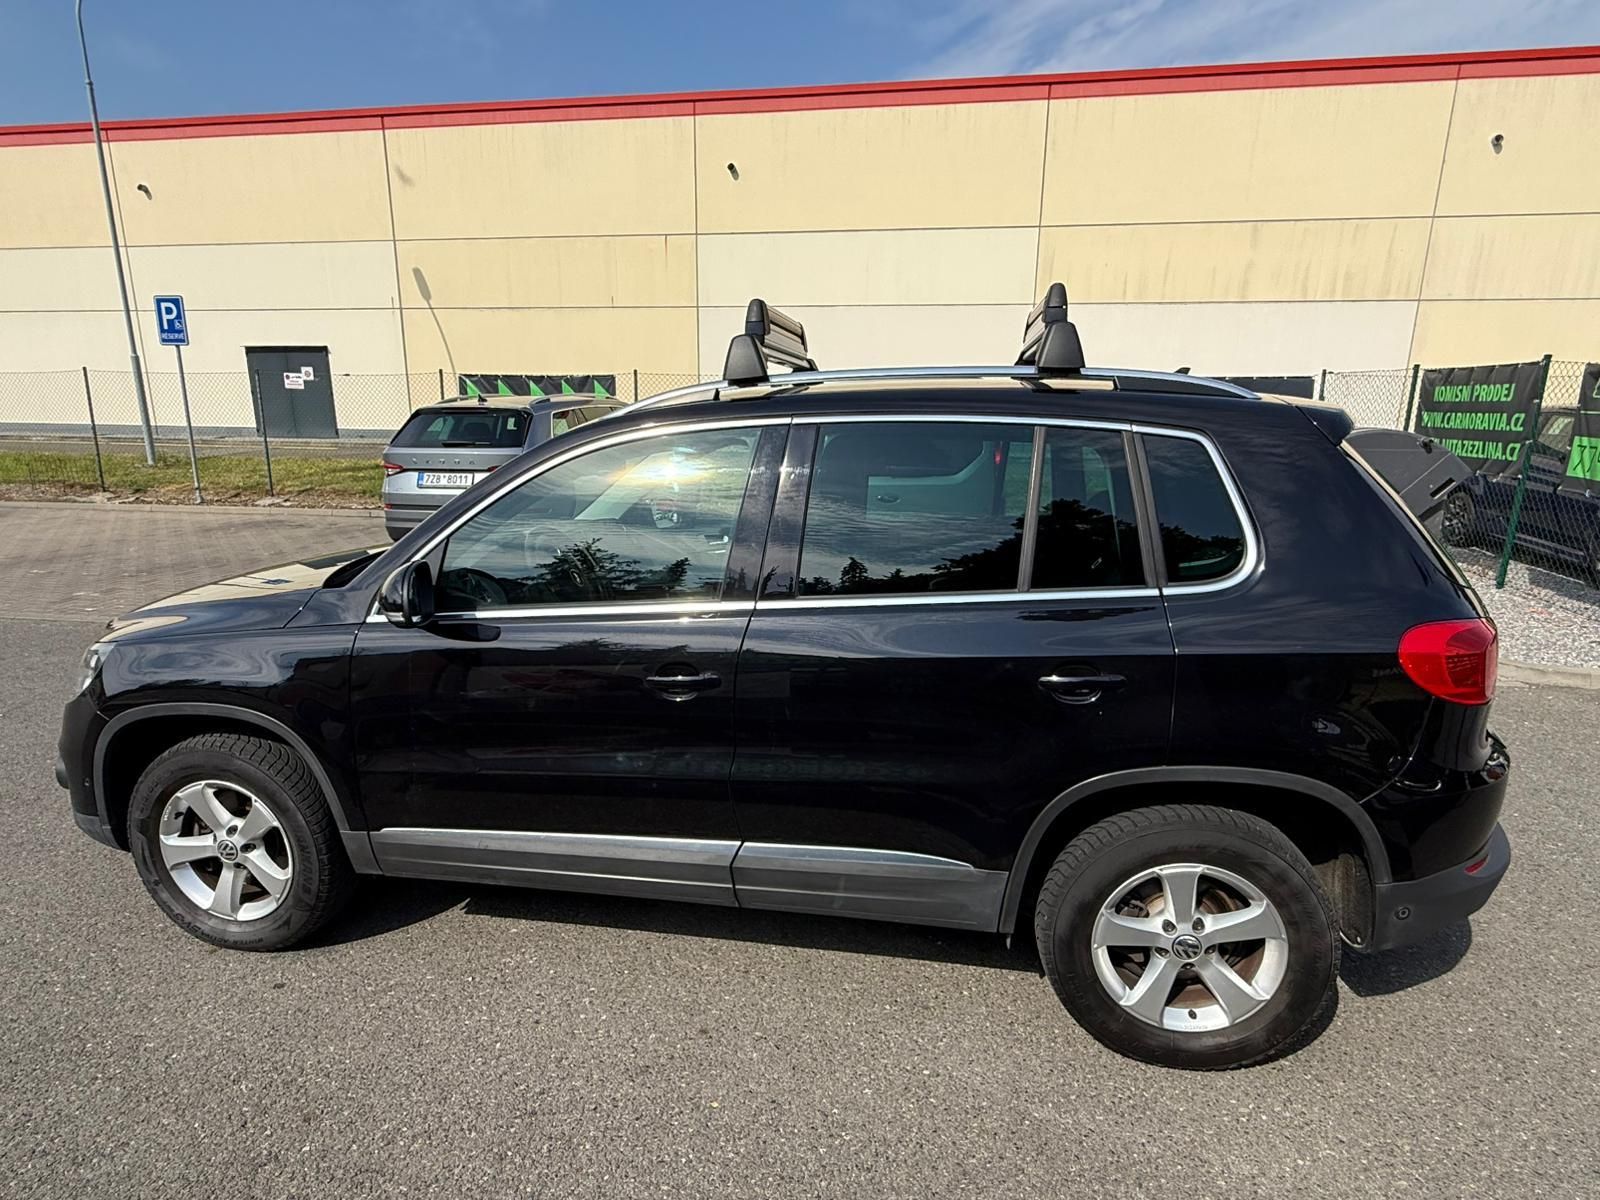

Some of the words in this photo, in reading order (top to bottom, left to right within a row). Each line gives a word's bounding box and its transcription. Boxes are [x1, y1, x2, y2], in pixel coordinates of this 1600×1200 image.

[160, 302, 177, 330] P
[1472, 383, 1516, 402] PRODEJ
[1421, 411, 1526, 432] WWW.CARMORAVIA.CZ
[1573, 444, 1600, 473] 77
[447, 474, 468, 484] 8011
